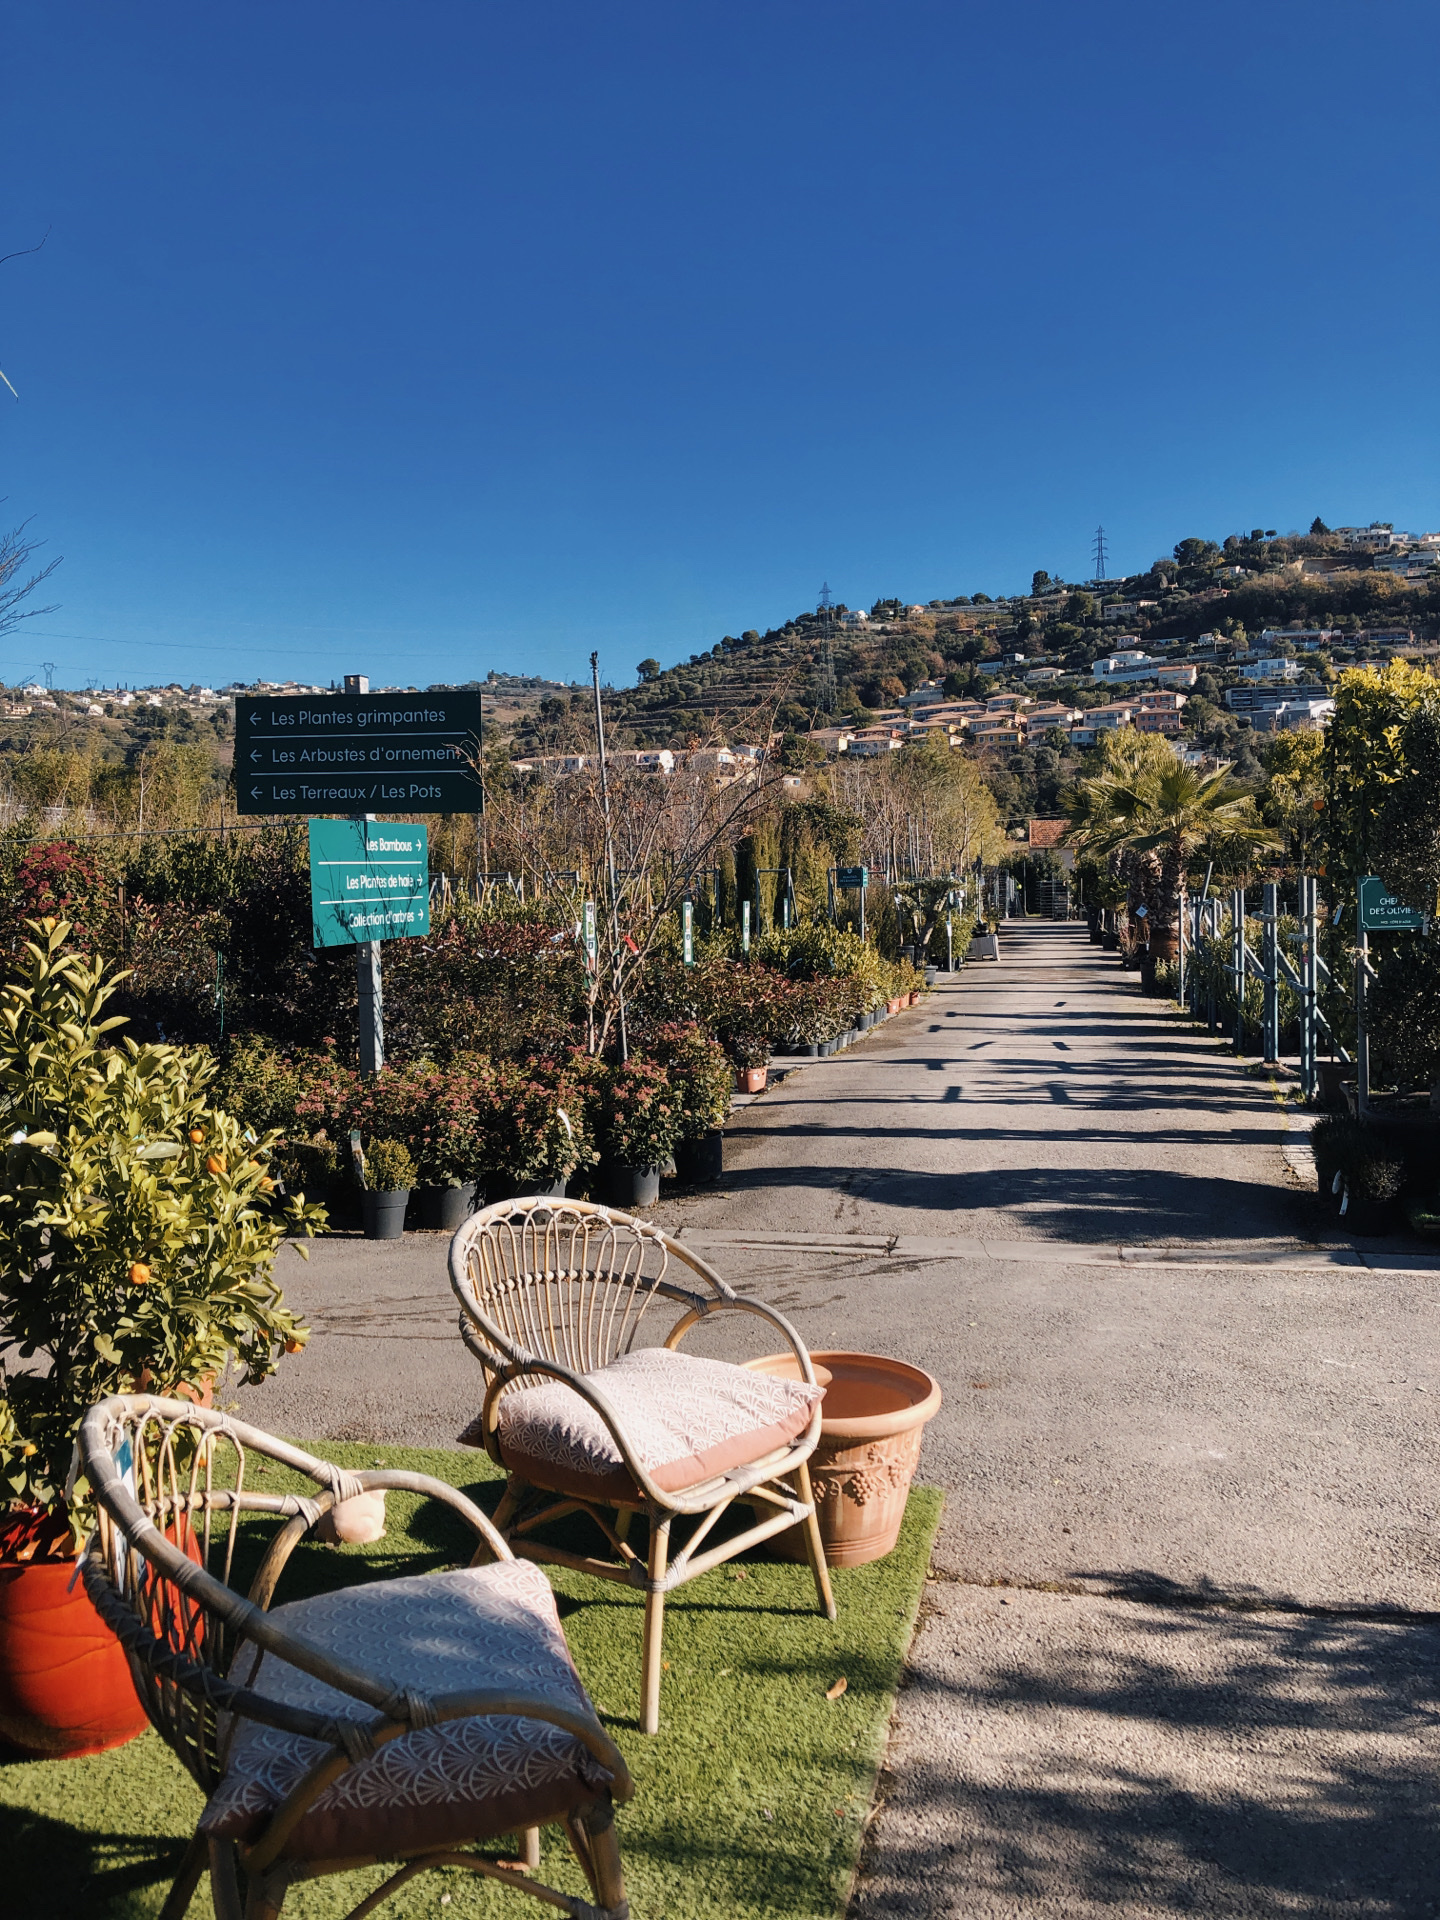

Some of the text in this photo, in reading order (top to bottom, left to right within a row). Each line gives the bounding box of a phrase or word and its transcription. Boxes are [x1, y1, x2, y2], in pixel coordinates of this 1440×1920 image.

[271, 708, 446, 728] Les Plantes grimpantes
[272, 748, 296, 763] Les
[300, 747, 366, 762] Arbustes
[273, 785, 296, 800] Les
[300, 785, 367, 799] Terreaux
[381, 784, 406, 798] Les
[409, 783, 442, 798] Pots
[366, 837, 412, 852] Les Bambous
[346, 873, 414, 890] Les Plantes de haie
[349, 909, 415, 928] Collection d'arbres
[1369, 907, 1386, 915] DES
